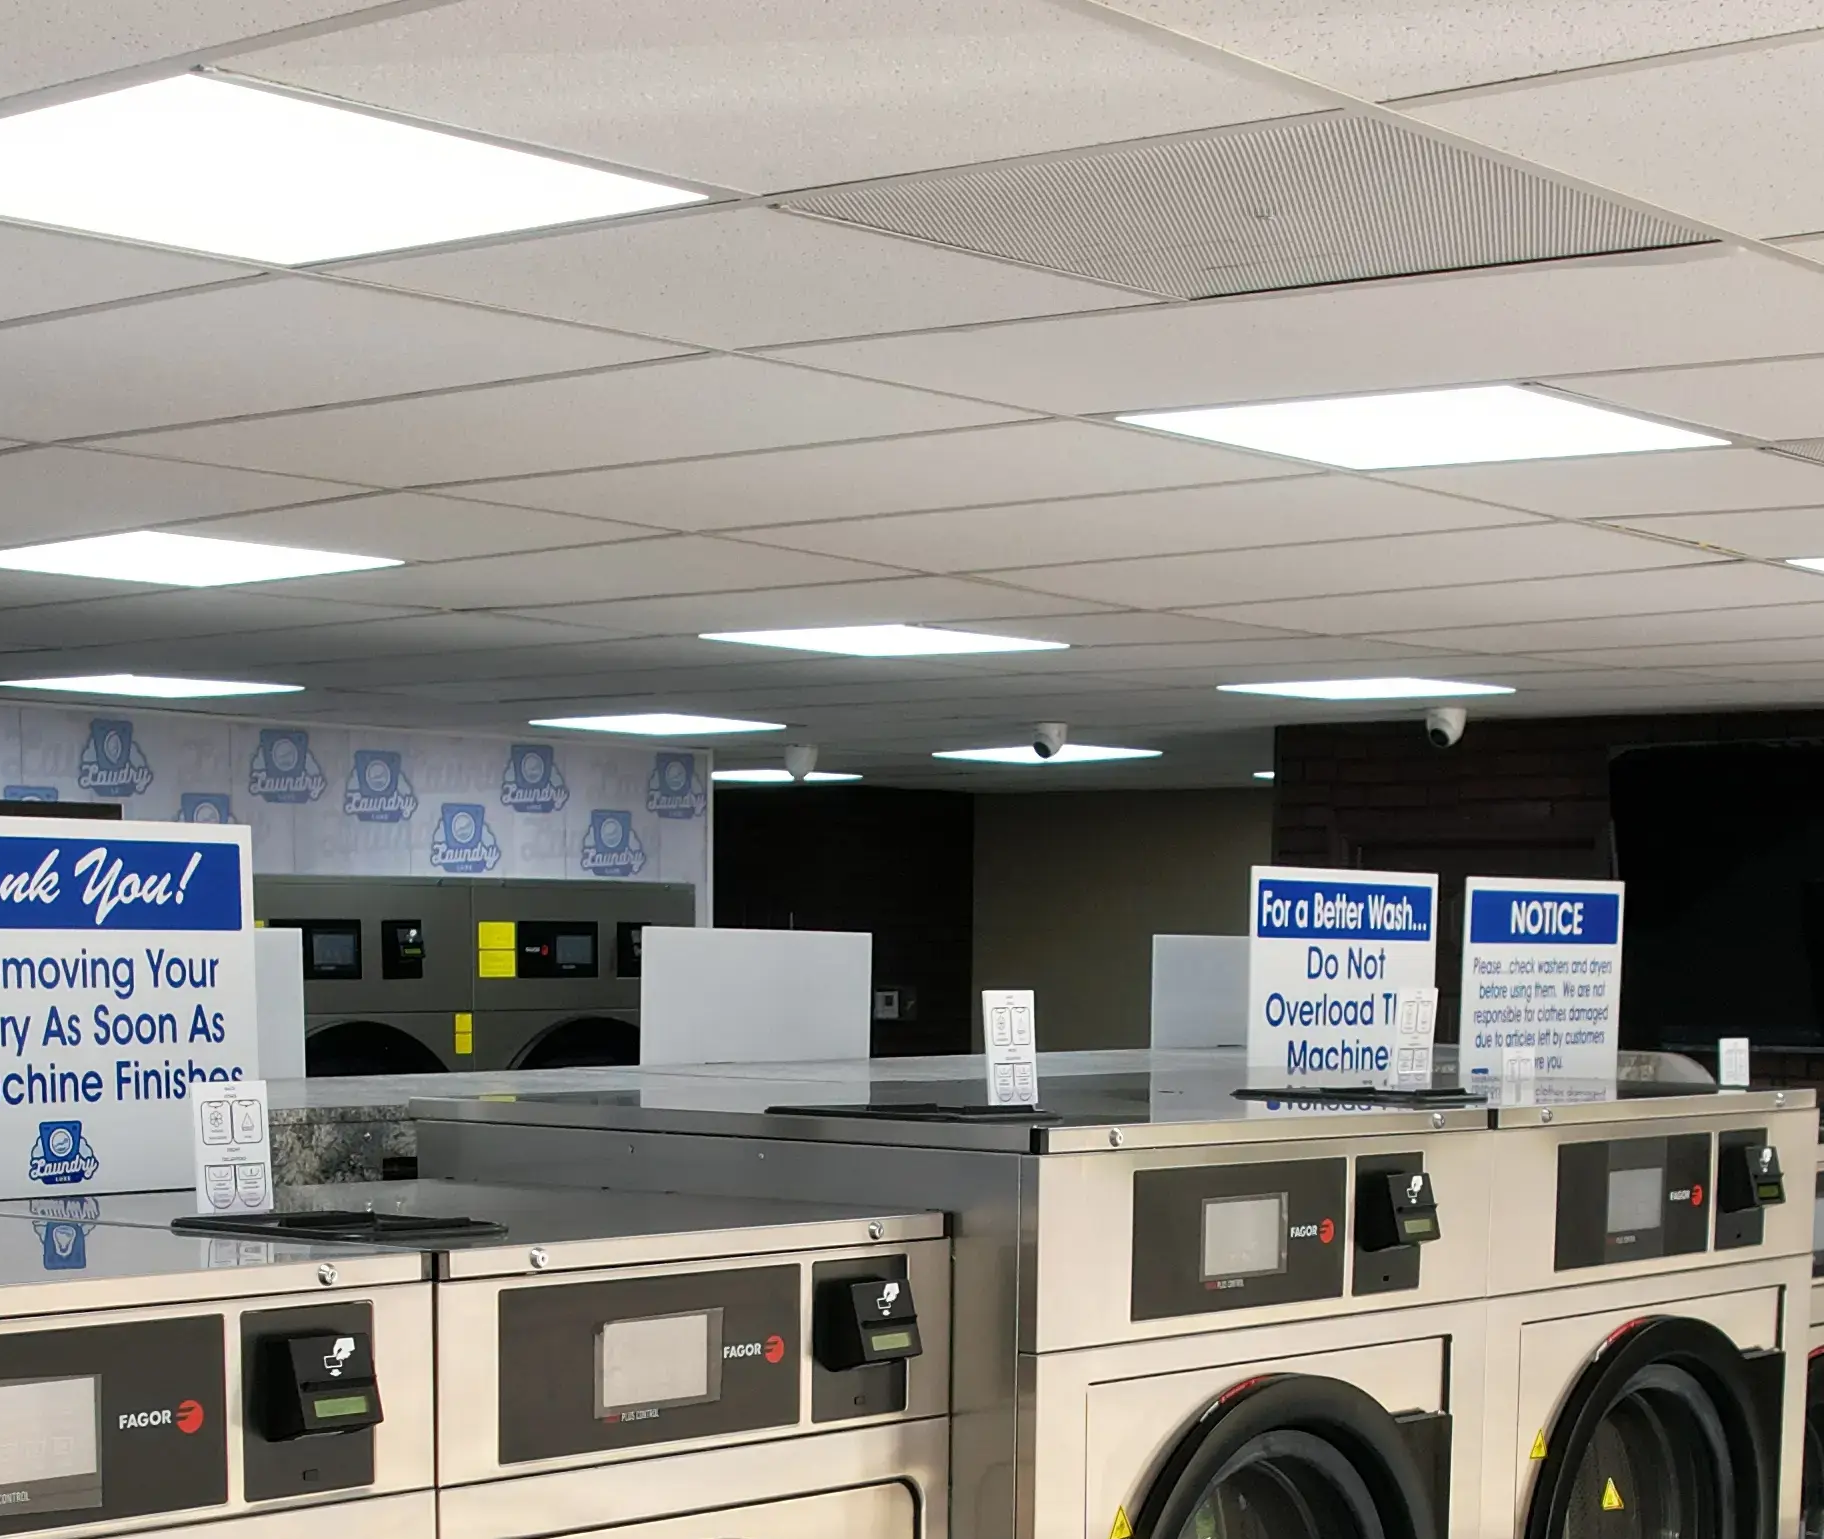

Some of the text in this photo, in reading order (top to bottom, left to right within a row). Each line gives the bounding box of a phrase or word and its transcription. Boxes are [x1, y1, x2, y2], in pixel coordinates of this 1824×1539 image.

[251, 771, 325, 798] Laundry
[502, 784, 569, 810] Laundry
[346, 791, 416, 820] Laundry
[432, 843, 499, 871] Laundry
[582, 847, 645, 874] Laundry
[74, 847, 203, 926] You!
[1261, 889, 1427, 933] For a Better Wash...
[1511, 900, 1584, 935] NOTICE
[145, 948, 219, 989] Your
[1307, 946, 1386, 981] Do Not
[1538, 958, 1569, 975] washers
[1571, 958, 1587, 974] and
[1479, 981, 1508, 999] before
[1510, 982, 1532, 1003] using
[1562, 981, 1576, 997] We
[1577, 985, 1591, 997] are
[1592, 981, 1606, 997] not
[1265, 992, 1375, 1027] Overload
[1473, 1004, 1609, 1026] responsible for clothes damaged
[42, 1006, 82, 1047] As
[93, 1004, 177, 1045] Soon
[188, 1003, 226, 1044] As
[1475, 1029, 1606, 1048] due to articles left by customers
[1287, 1038, 1393, 1074] Machine
[31, 1154, 97, 1178] Laundry
[1290, 1225, 1318, 1238] FAGOR
[723, 1343, 762, 1359] FAGOR
[119, 1409, 172, 1430] FAGOR
